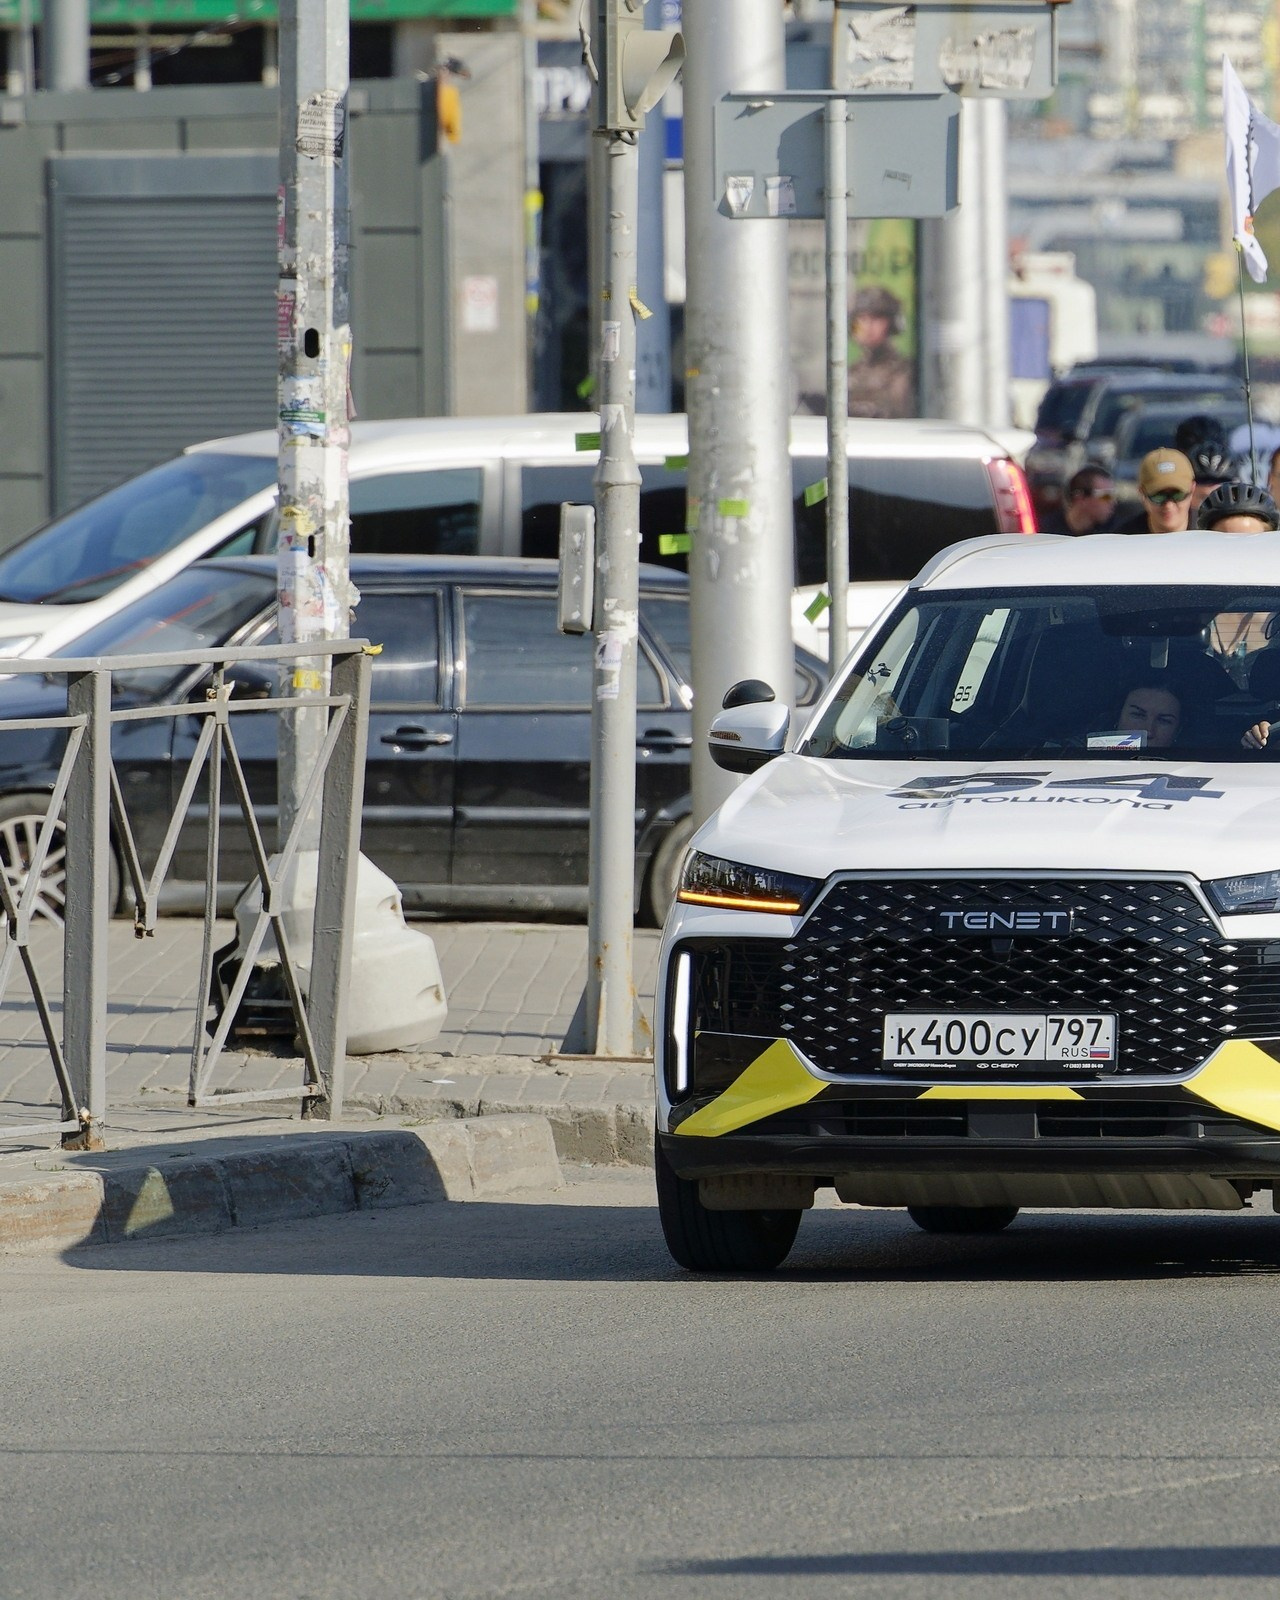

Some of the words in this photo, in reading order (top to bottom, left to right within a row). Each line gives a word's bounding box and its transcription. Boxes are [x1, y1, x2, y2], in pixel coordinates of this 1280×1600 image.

[885, 771, 1226, 801] 54
[898, 795, 1174, 811] автошкола
[940, 911, 1068, 929] TENET
[896, 1019, 1040, 1056] К400СУ
[1048, 1018, 1103, 1046] 797
[1061, 1047, 1088, 1057] RUS
